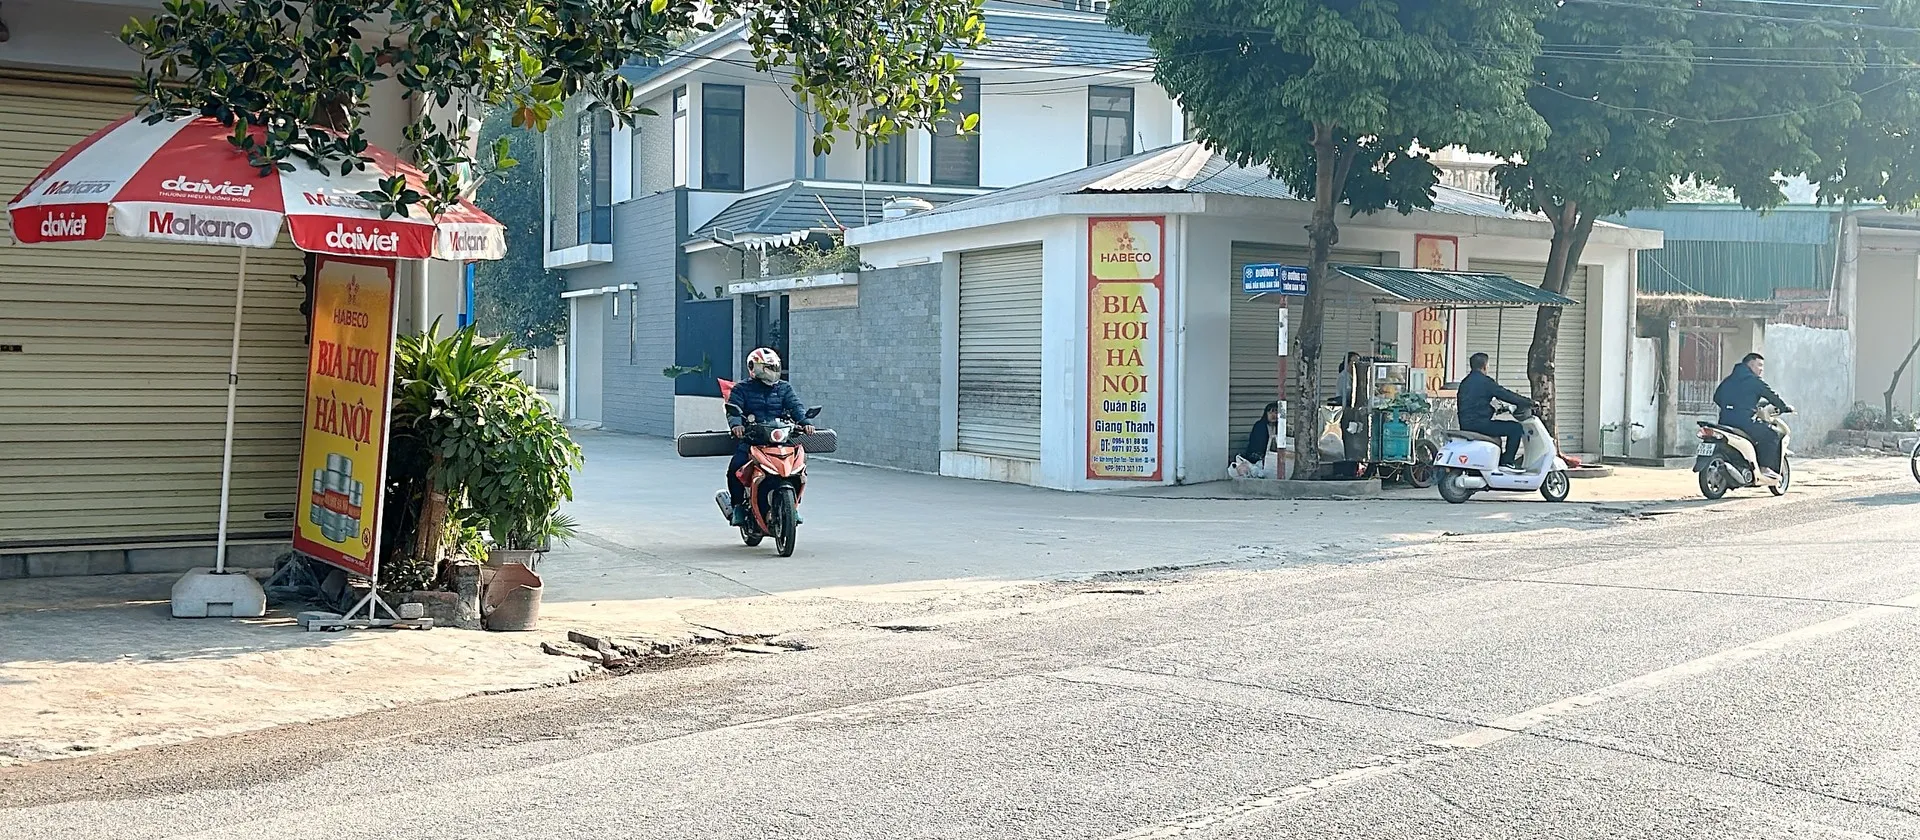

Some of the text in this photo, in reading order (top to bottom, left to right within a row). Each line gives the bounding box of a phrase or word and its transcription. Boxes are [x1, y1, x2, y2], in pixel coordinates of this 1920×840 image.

[42, 180, 110, 196] Makano
[161, 175, 255, 197] daiviet
[40, 211, 87, 237] daiviet
[148, 211, 253, 240] Makano
[325, 222, 400, 252] daiviet
[1100, 252, 1152, 263] HABECO
[1102, 295, 1149, 314] BIA
[333, 308, 369, 329] HABECO
[1102, 320, 1150, 341] HƠI
[316, 340, 345, 380] BIA
[1105, 345, 1145, 367] HÀ
[1424, 349, 1444, 368] HÀ
[1101, 371, 1149, 396] NỘI
[1103, 400, 1147, 413] Quán Bia
[313, 389, 374, 452] HÀ NỘI
[1095, 420, 1155, 434] Giang Thanh
[1100, 438, 1111, 452] ĐT:
